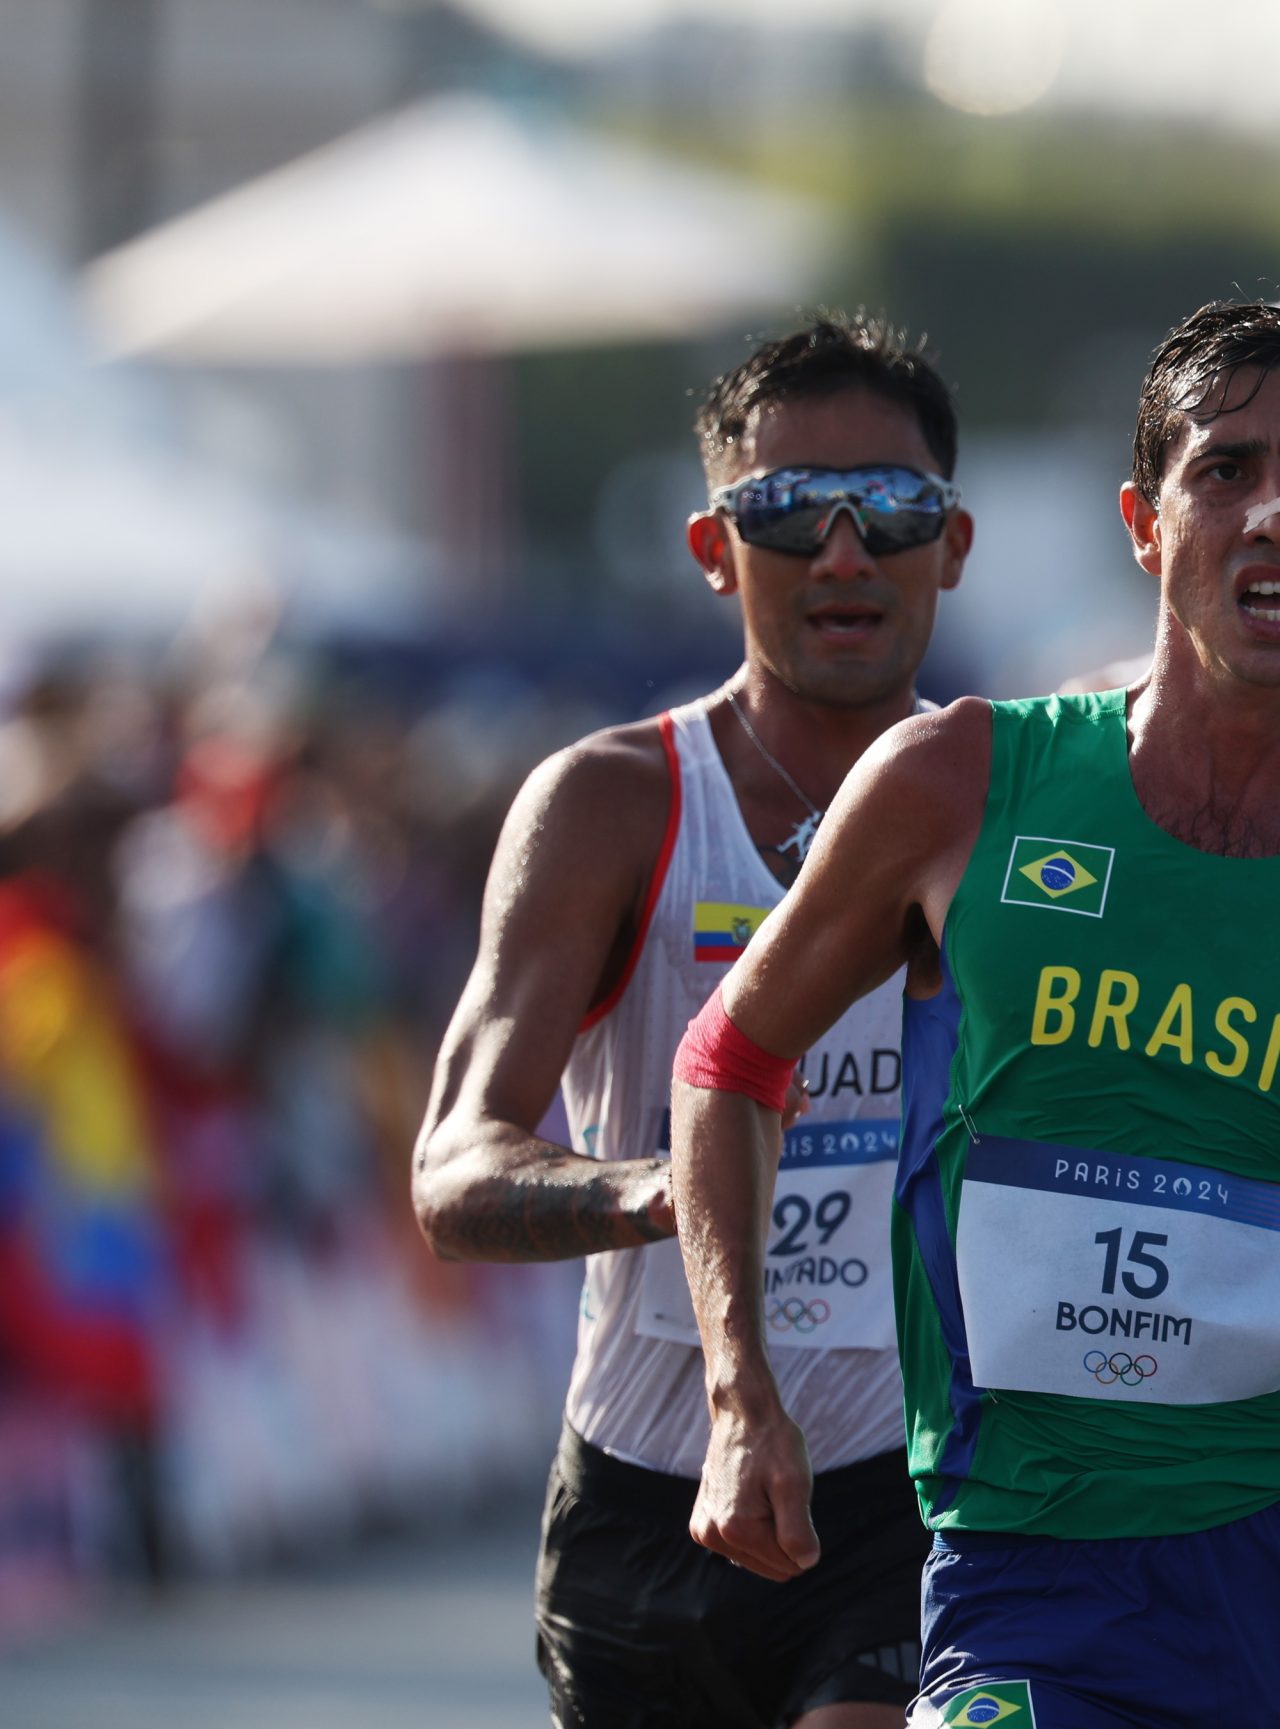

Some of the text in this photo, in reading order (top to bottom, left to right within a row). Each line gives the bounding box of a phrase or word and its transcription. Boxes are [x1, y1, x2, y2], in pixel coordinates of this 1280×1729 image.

[799, 1049, 902, 1097] UAD
[822, 1131, 898, 1155] 2024
[1153, 1174, 1229, 1205] 2024
[768, 1190, 852, 1257] 29
[1094, 1227, 1169, 1300] 15
[1055, 1301, 1193, 1346] BONFIM
